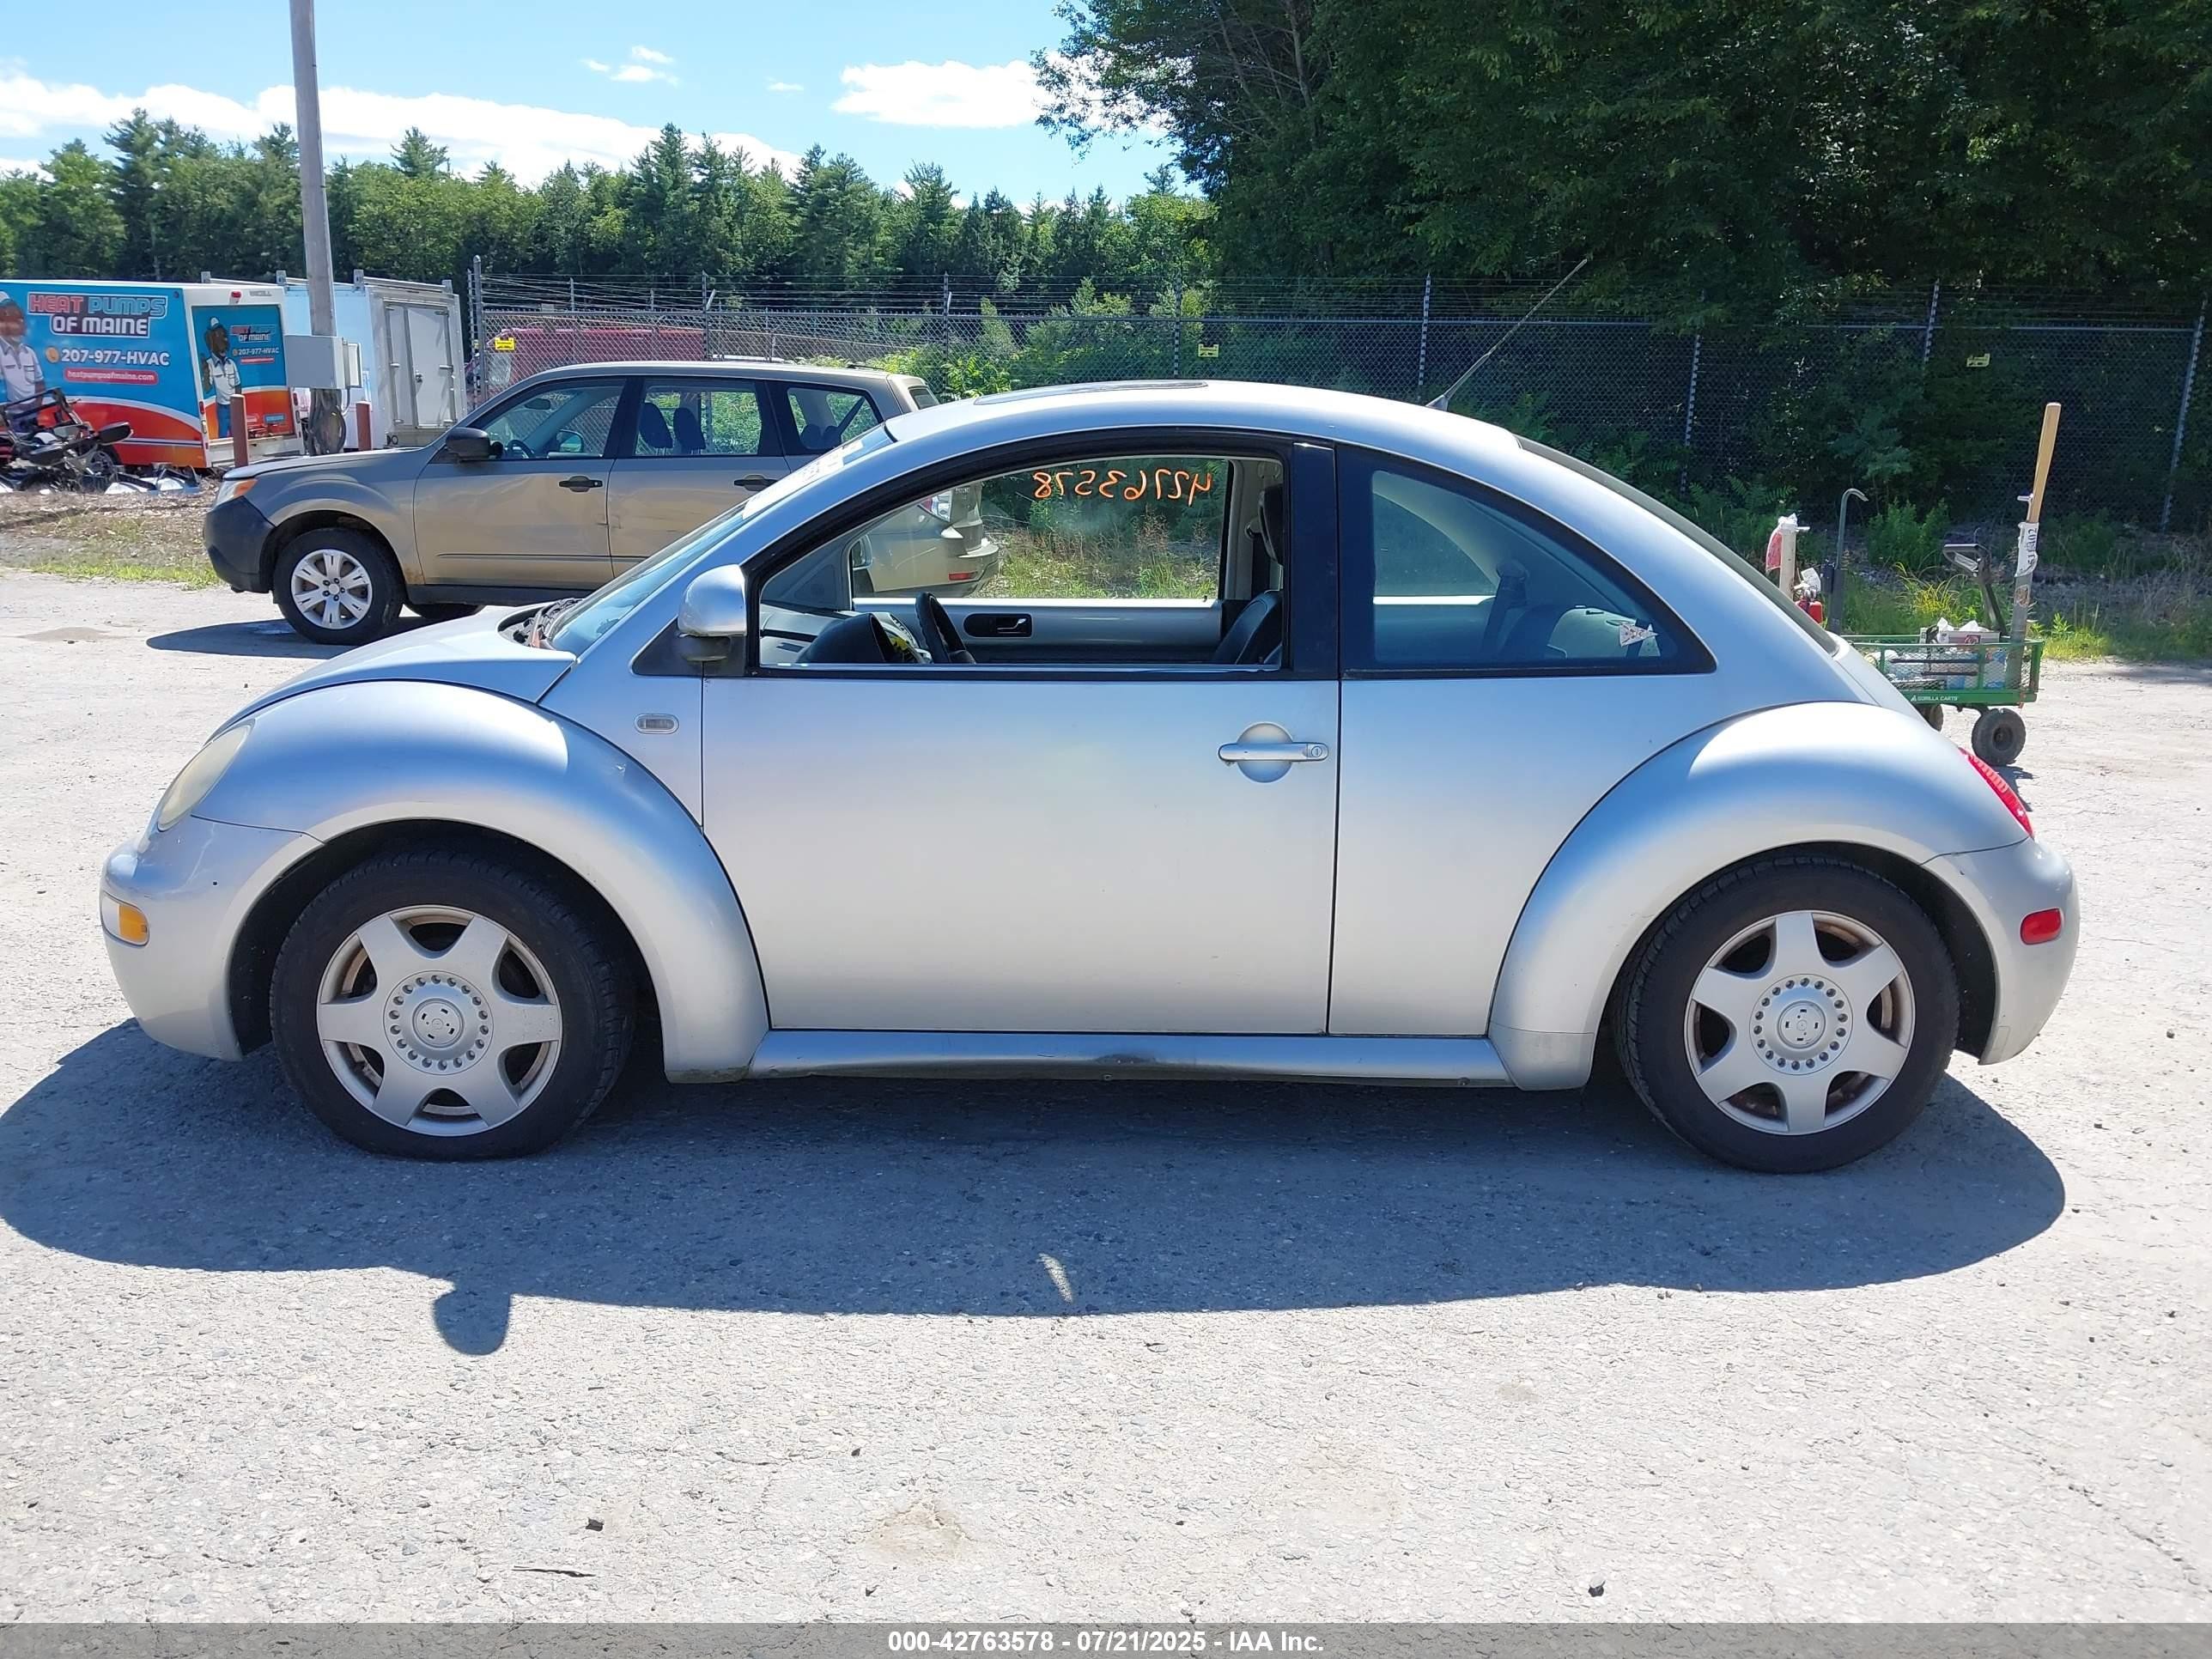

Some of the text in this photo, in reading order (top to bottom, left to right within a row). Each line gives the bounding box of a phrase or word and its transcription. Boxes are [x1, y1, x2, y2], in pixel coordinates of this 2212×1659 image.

[29, 295, 167, 317] HEAT PUMPS
[52, 316, 148, 335] OF MAINE
[61, 349, 170, 366] 207-977-HVAC
